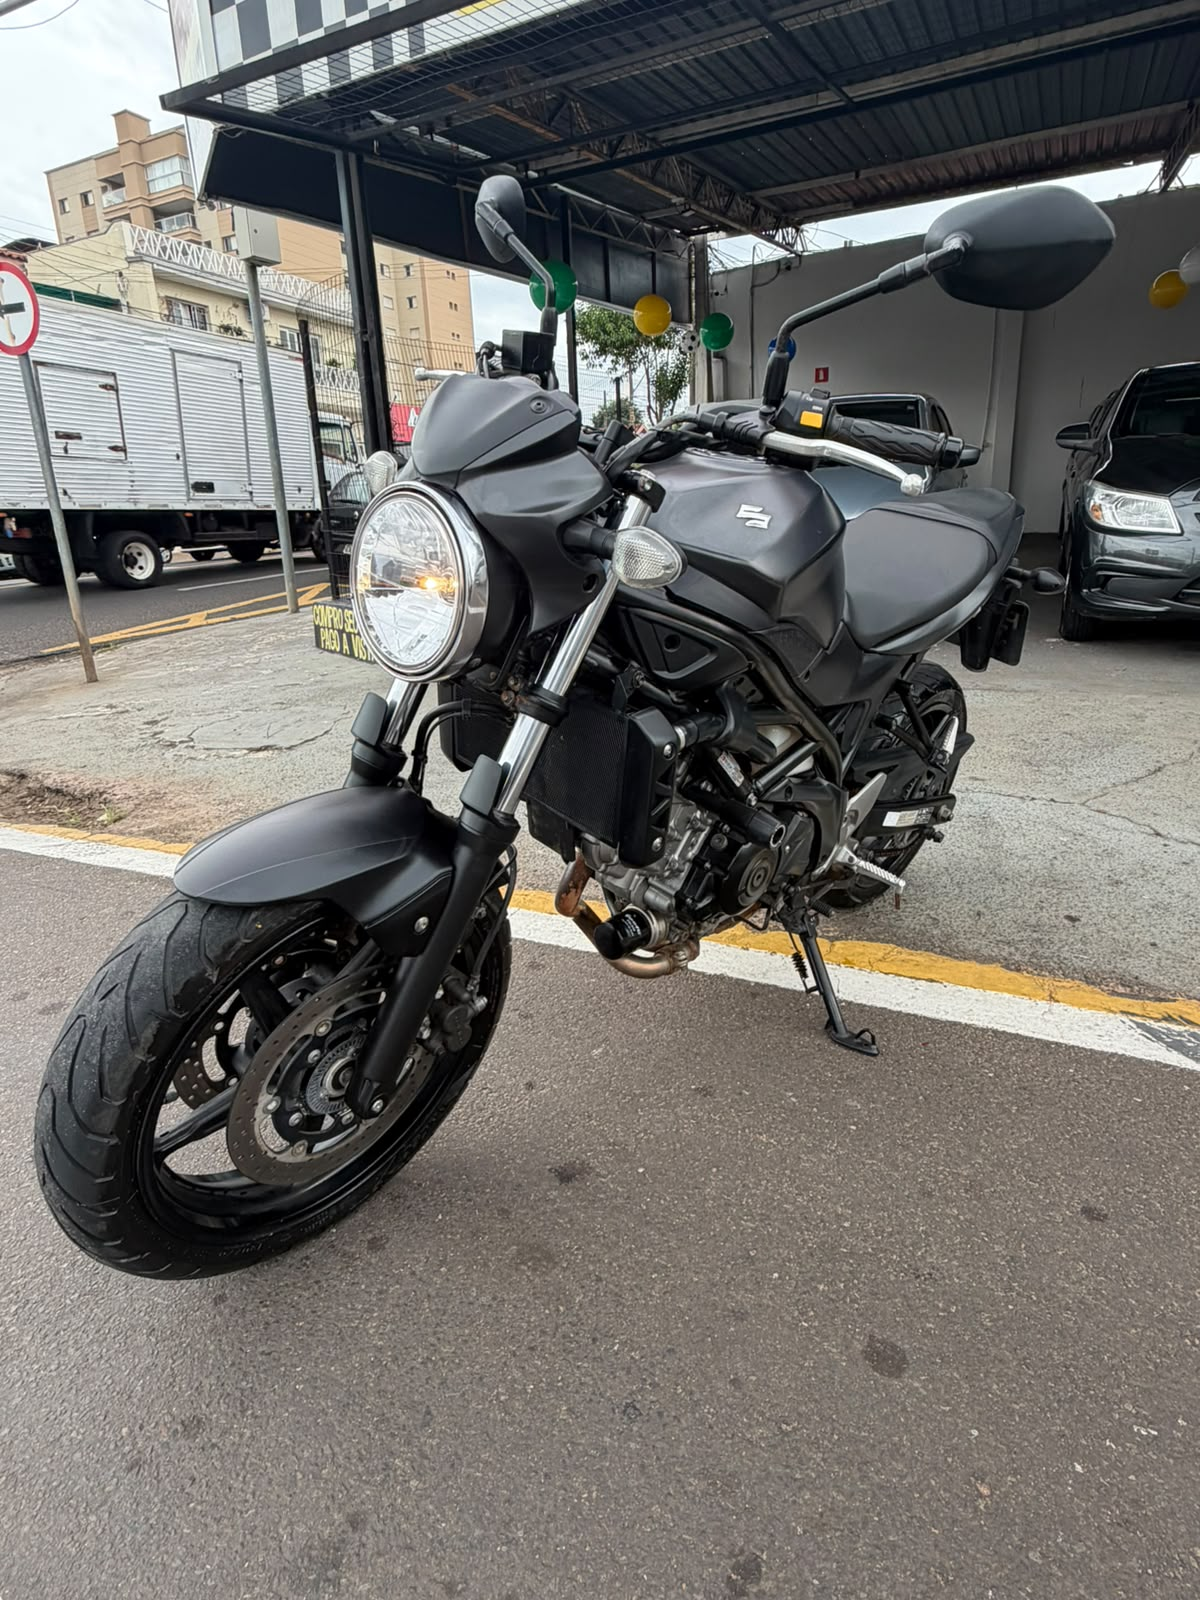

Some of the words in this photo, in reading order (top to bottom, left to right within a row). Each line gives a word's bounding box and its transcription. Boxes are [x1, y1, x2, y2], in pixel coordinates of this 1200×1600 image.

[313, 605, 343, 630] COMPRO
[320, 628, 340, 652] PAGO
[342, 633, 350, 655] A
